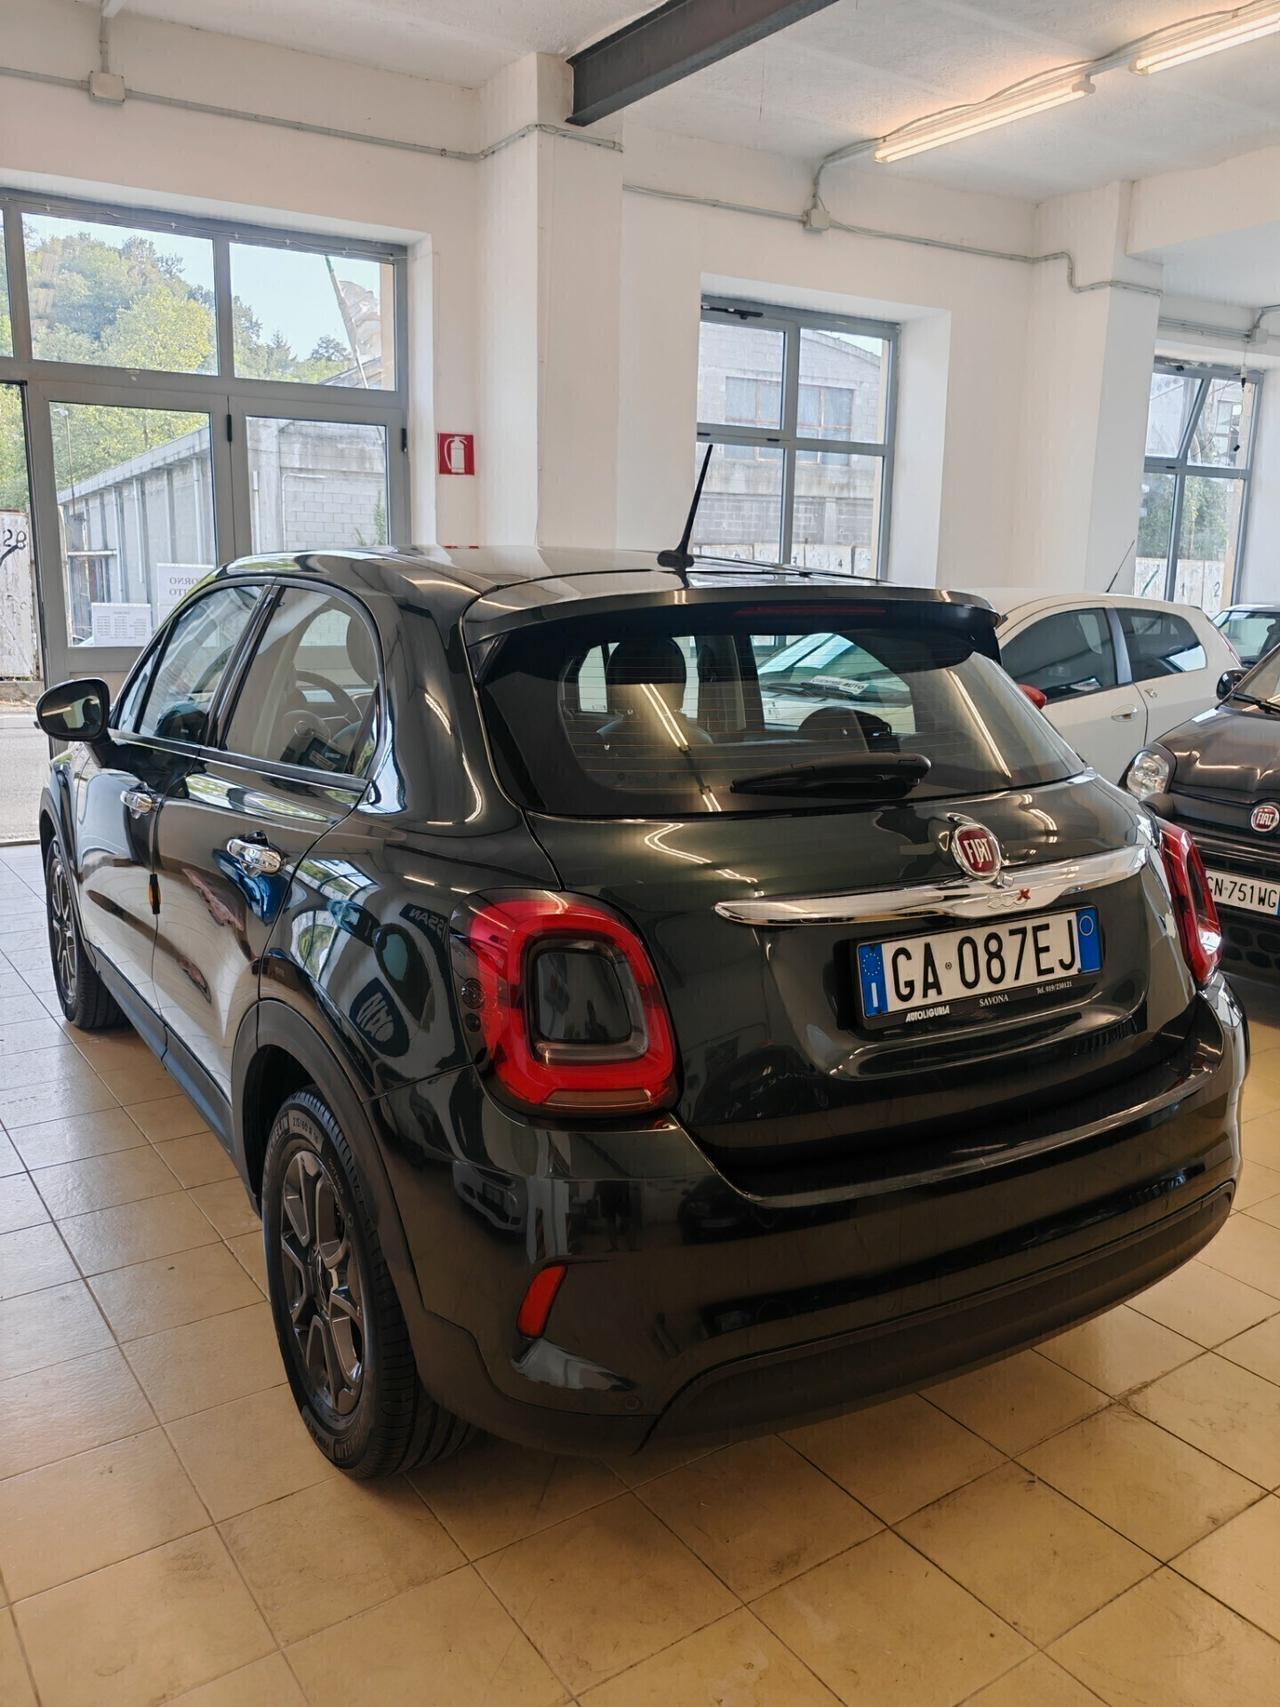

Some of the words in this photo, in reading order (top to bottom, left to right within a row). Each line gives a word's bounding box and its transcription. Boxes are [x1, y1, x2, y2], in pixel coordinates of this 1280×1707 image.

[1256, 812, 1274, 826] FIAT
[963, 838, 992, 868] FIAT
[1228, 880, 1277, 909] 751WG
[905, 1004, 950, 1023] AUTOLIGURIA
[979, 993, 1009, 1008] SAVONA
